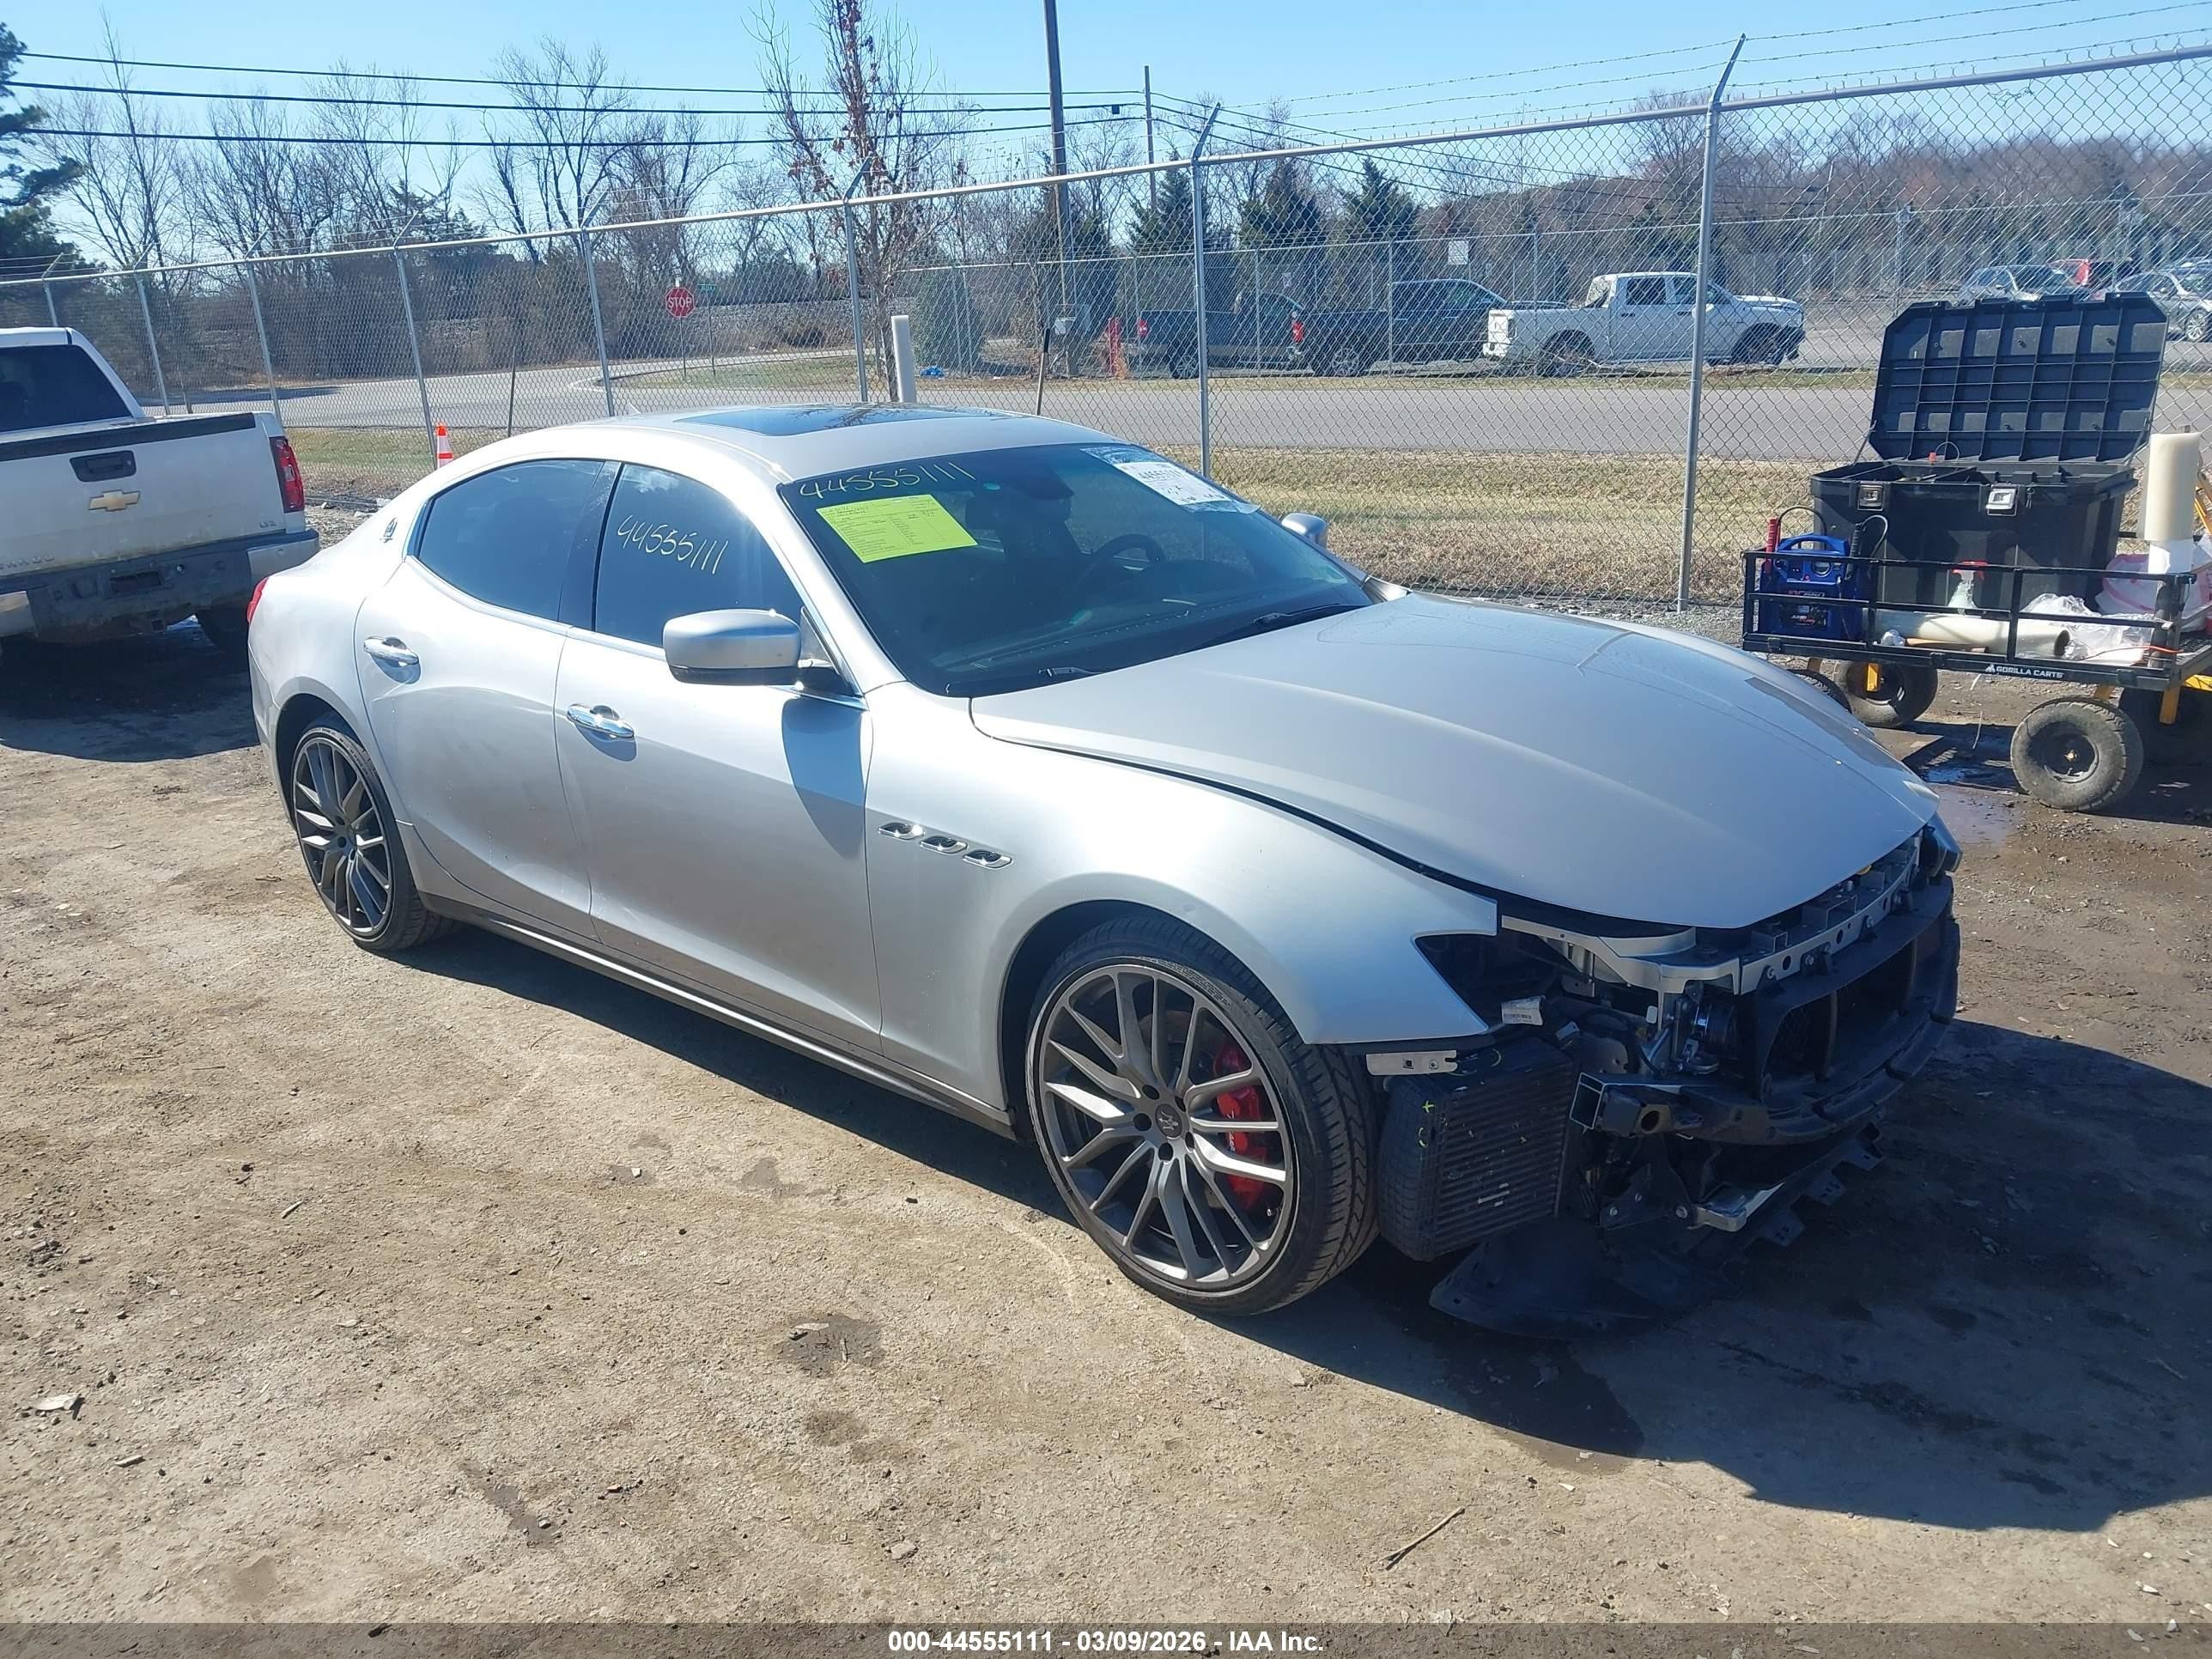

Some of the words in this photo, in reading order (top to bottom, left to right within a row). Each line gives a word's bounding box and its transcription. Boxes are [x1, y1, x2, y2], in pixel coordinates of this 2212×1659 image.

[667, 296, 692, 308] STOP
[799, 461, 976, 499] 44555111
[617, 514, 729, 575] 44555111
[1996, 665, 2032, 676] GORILLA
[2033, 670, 2063, 678] CARTS
